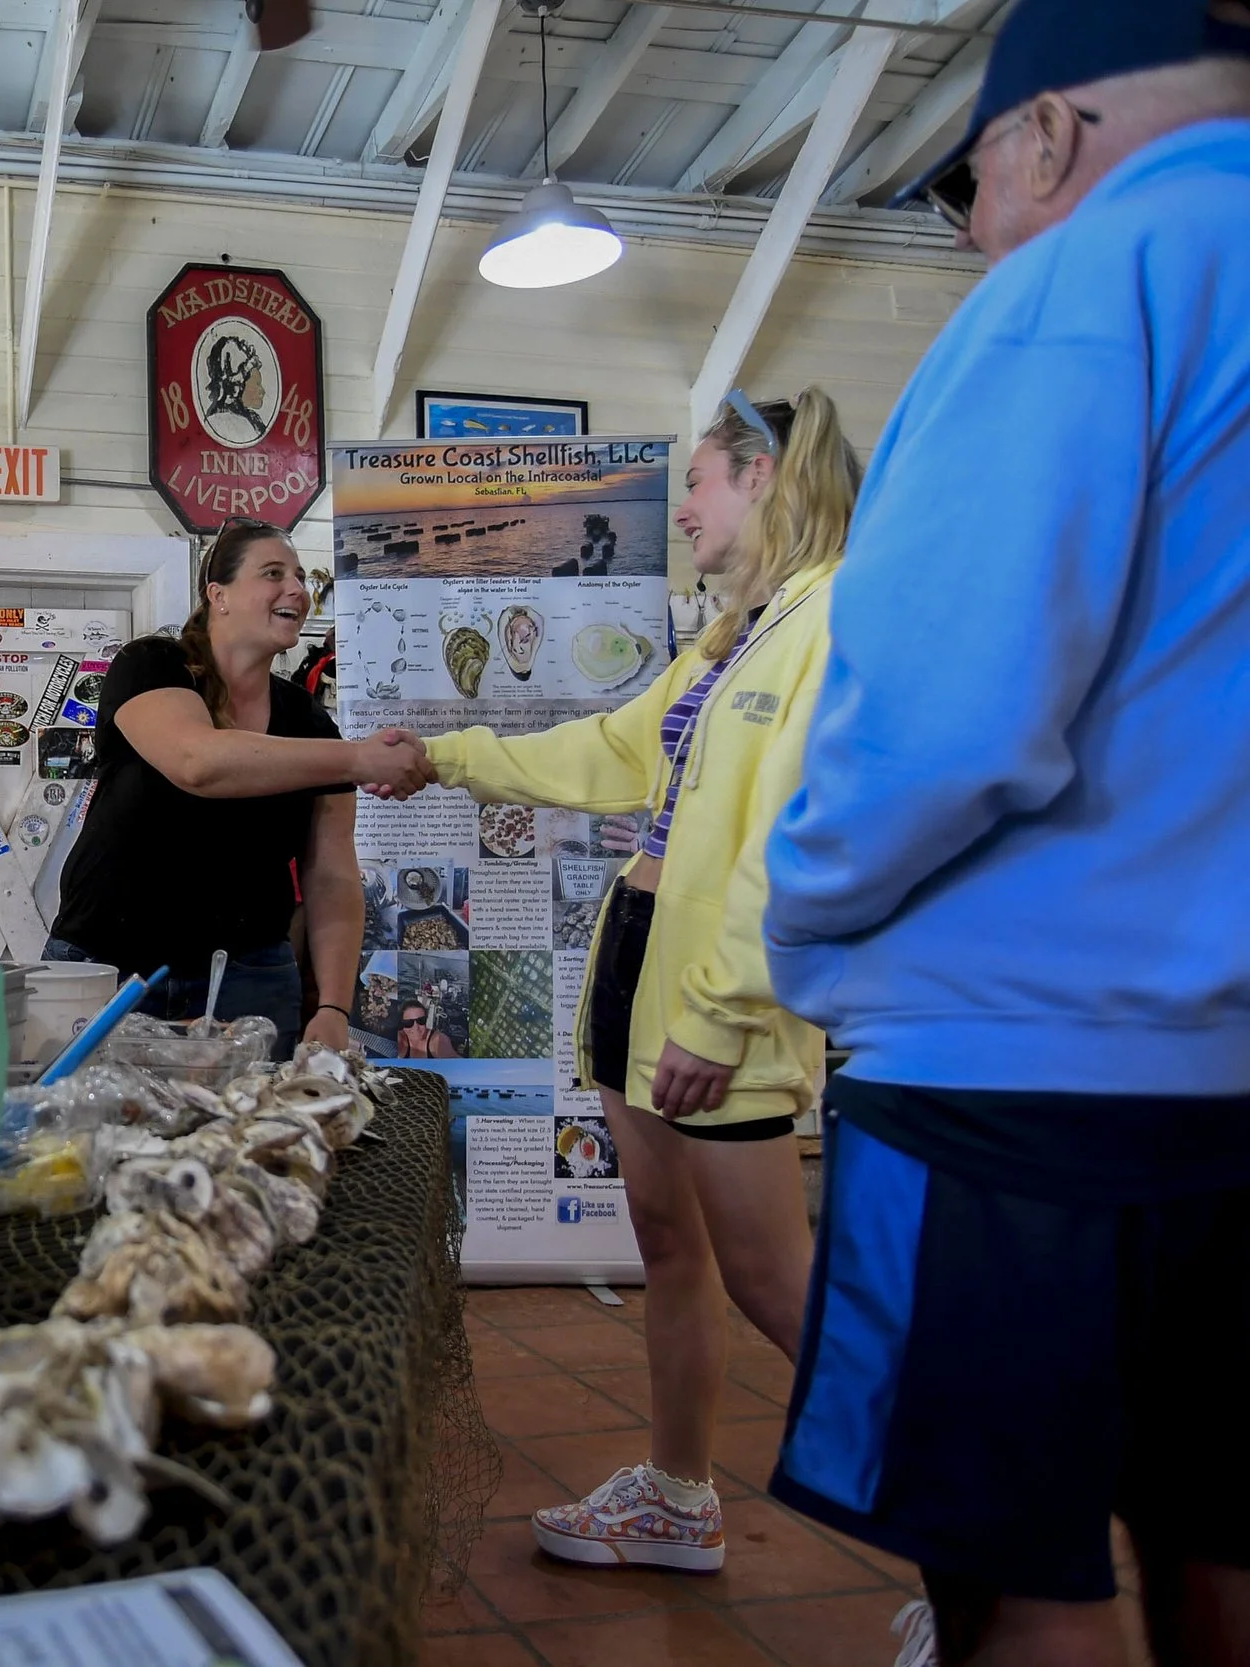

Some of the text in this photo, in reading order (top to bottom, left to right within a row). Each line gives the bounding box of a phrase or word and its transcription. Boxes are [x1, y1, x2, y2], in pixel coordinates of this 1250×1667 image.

[160, 380, 313, 448] 18 48
[345, 442, 655, 470] Treasure Coast Shellfish, LLC
[200, 450, 270, 477] INNE
[400, 469, 602, 485] Grown Local on the Intracoastal
[166, 465, 319, 514] LIVERPOOL
[359, 583, 408, 592] Oyster Life Cycle
[442, 578, 464, 586] Oysters
[577, 581, 603, 590] Anatomy
[604, 581, 611, 589] of
[622, 581, 641, 590] Oyster
[44, 656, 75, 702] MOTORCYCLES
[39, 698, 58, 714] FOR
[349, 709, 381, 717] Treasure
[382, 708, 404, 716] Coast
[406, 708, 438, 716] Shellfish
[440, 708, 447, 716] is
[449, 708, 462, 716] the
[463, 707, 478, 716] first
[479, 708, 502, 718] oyster
[504, 708, 522, 716] farm
[524, 708, 532, 716] in
[549, 708, 580, 718] growing
[344, 721, 367, 729] under
[369, 721, 375, 729] 7
[408, 721, 415, 729] is
[416, 721, 444, 729] located
[446, 721, 454, 729] in
[456, 721, 469, 729] the
[527, 720, 536, 729] of
[537, 720, 550, 729] the
[562, 863, 604, 872] SHELLFISH
[581, 1201, 595, 1209] Like
[581, 1209, 617, 1217] Facebook
